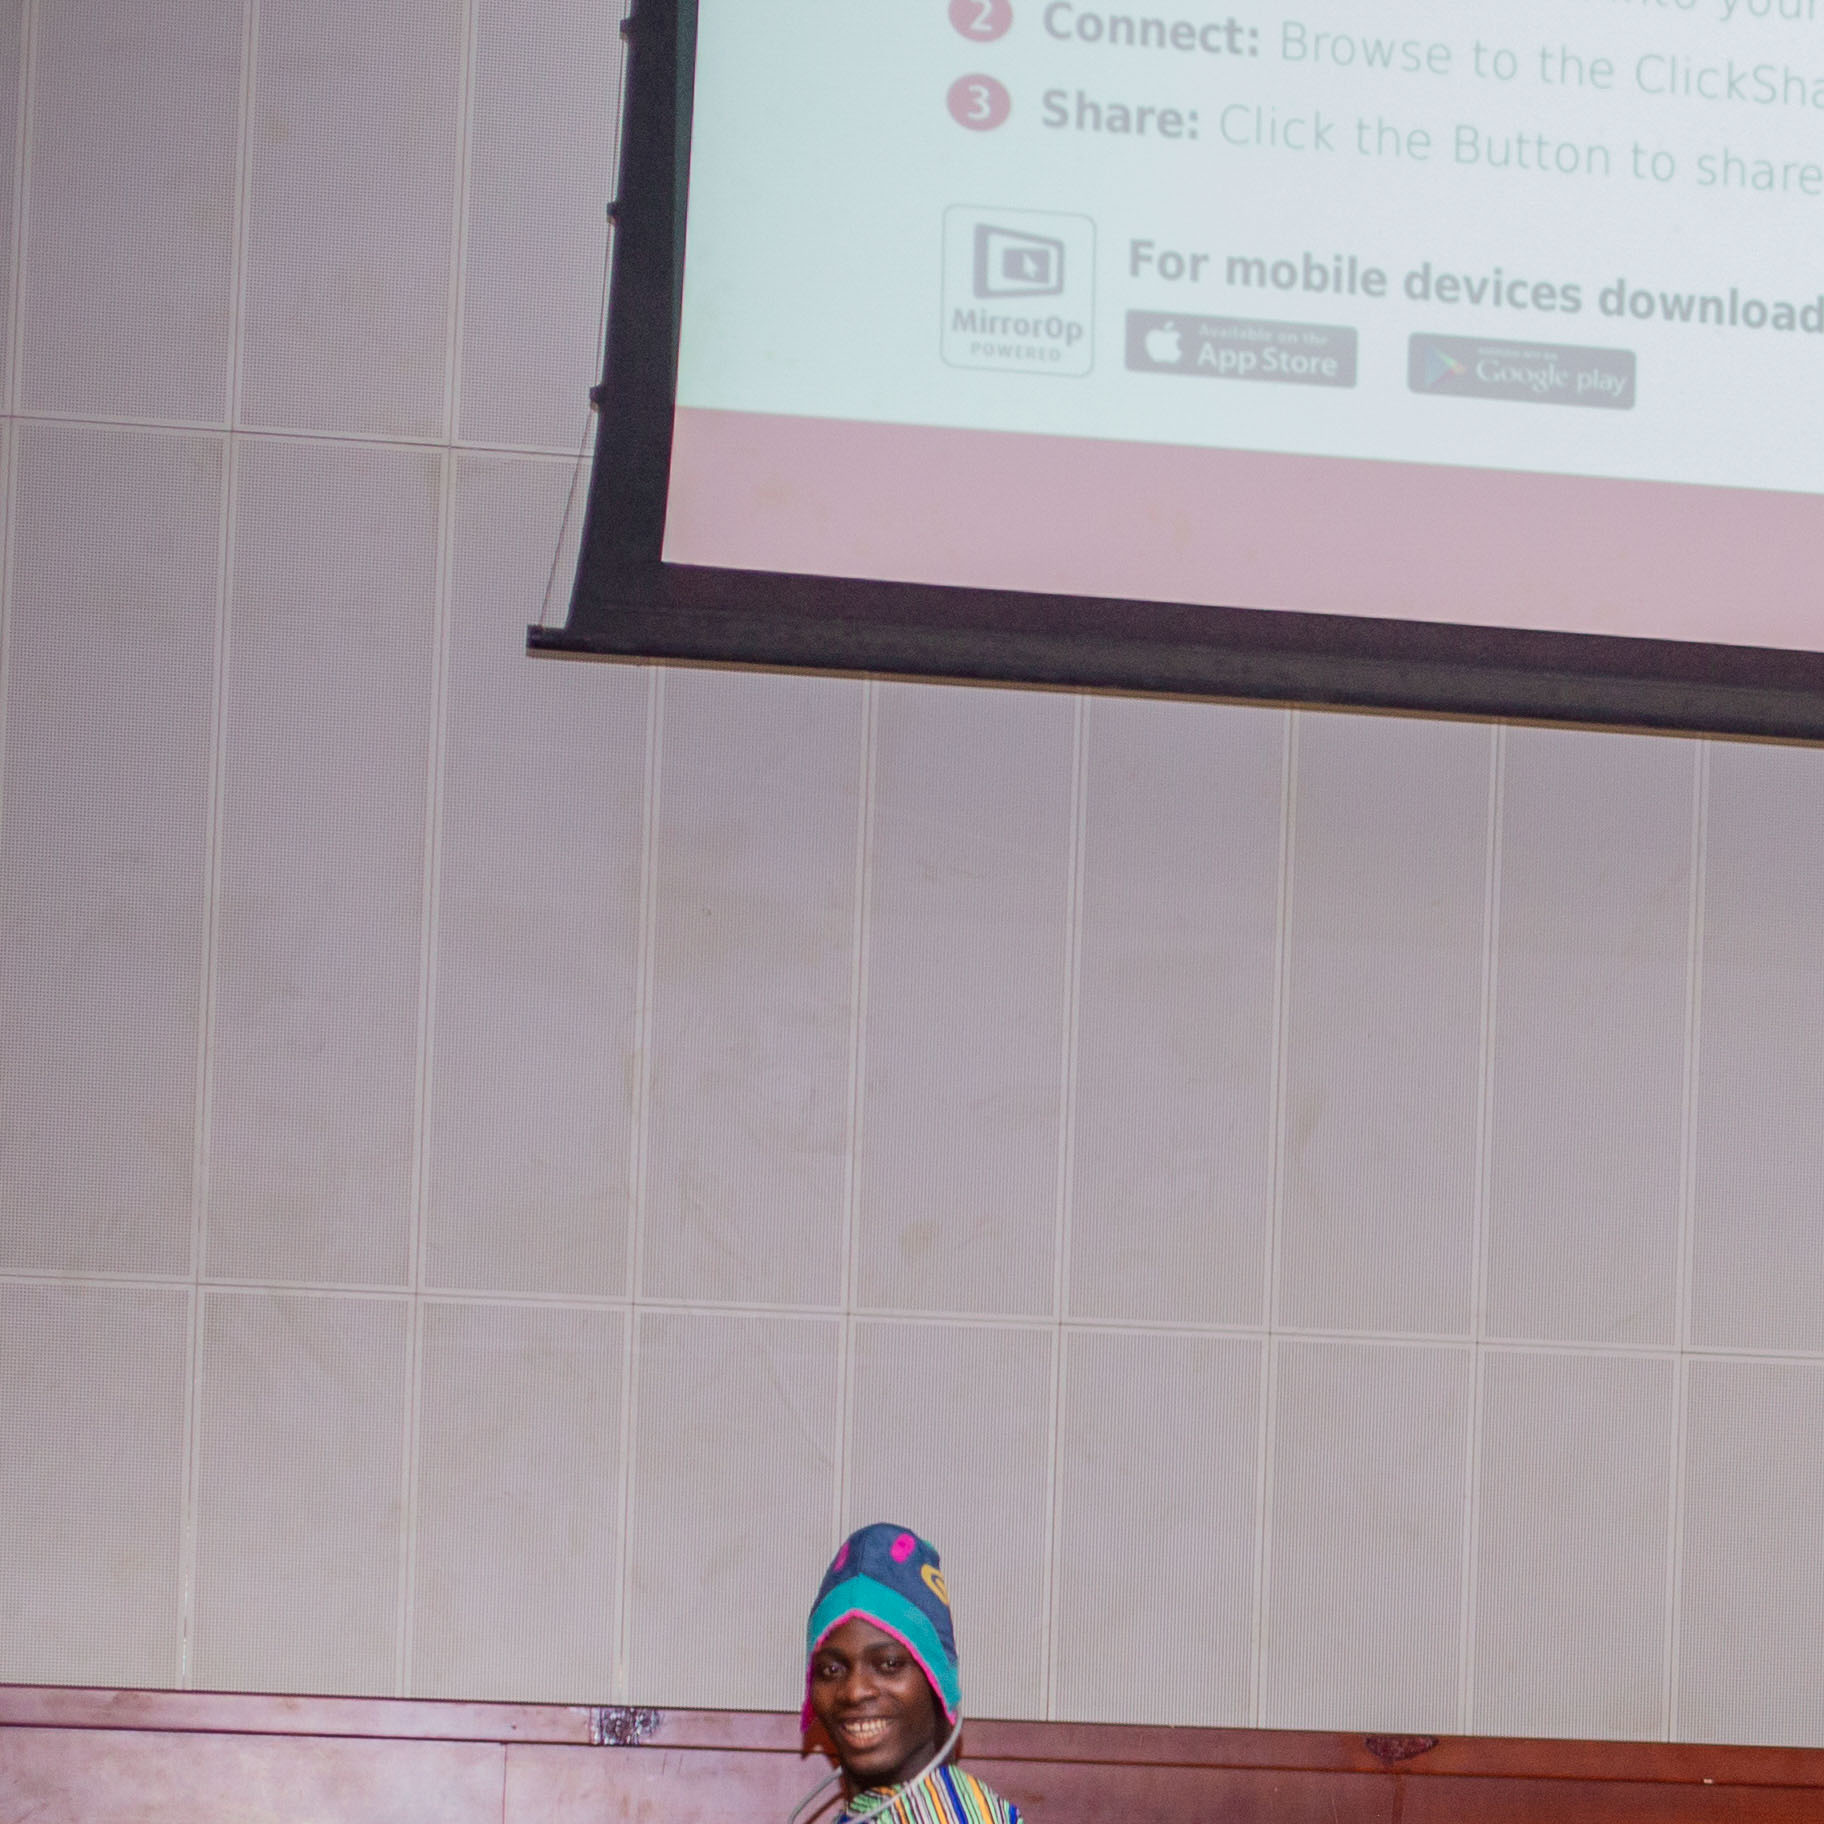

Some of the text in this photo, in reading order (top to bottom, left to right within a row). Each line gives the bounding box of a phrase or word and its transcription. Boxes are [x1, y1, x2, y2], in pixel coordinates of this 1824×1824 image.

[971, 0, 994, 31] 2
[1042, 0, 1260, 58] Connect:
[1281, 19, 1453, 76] Browse
[1473, 40, 1518, 82] to
[1538, 44, 1615, 90] the
[967, 86, 992, 120] 3
[1042, 87, 1199, 141] Share:
[1219, 103, 1335, 152] Click
[1356, 116, 1432, 162] the
[1454, 123, 1611, 176] Button
[1631, 141, 1677, 183] to
[1697, 147, 1824, 196] share
[1129, 238, 1210, 283] For
[1225, 250, 1388, 299] mobile
[1402, 260, 1583, 314] devices
[951, 307, 1083, 346] MirrorOp
[971, 341, 1062, 362] POWERED
[1196, 341, 1338, 377] App Store
[1475, 358, 1628, 397] Google play
